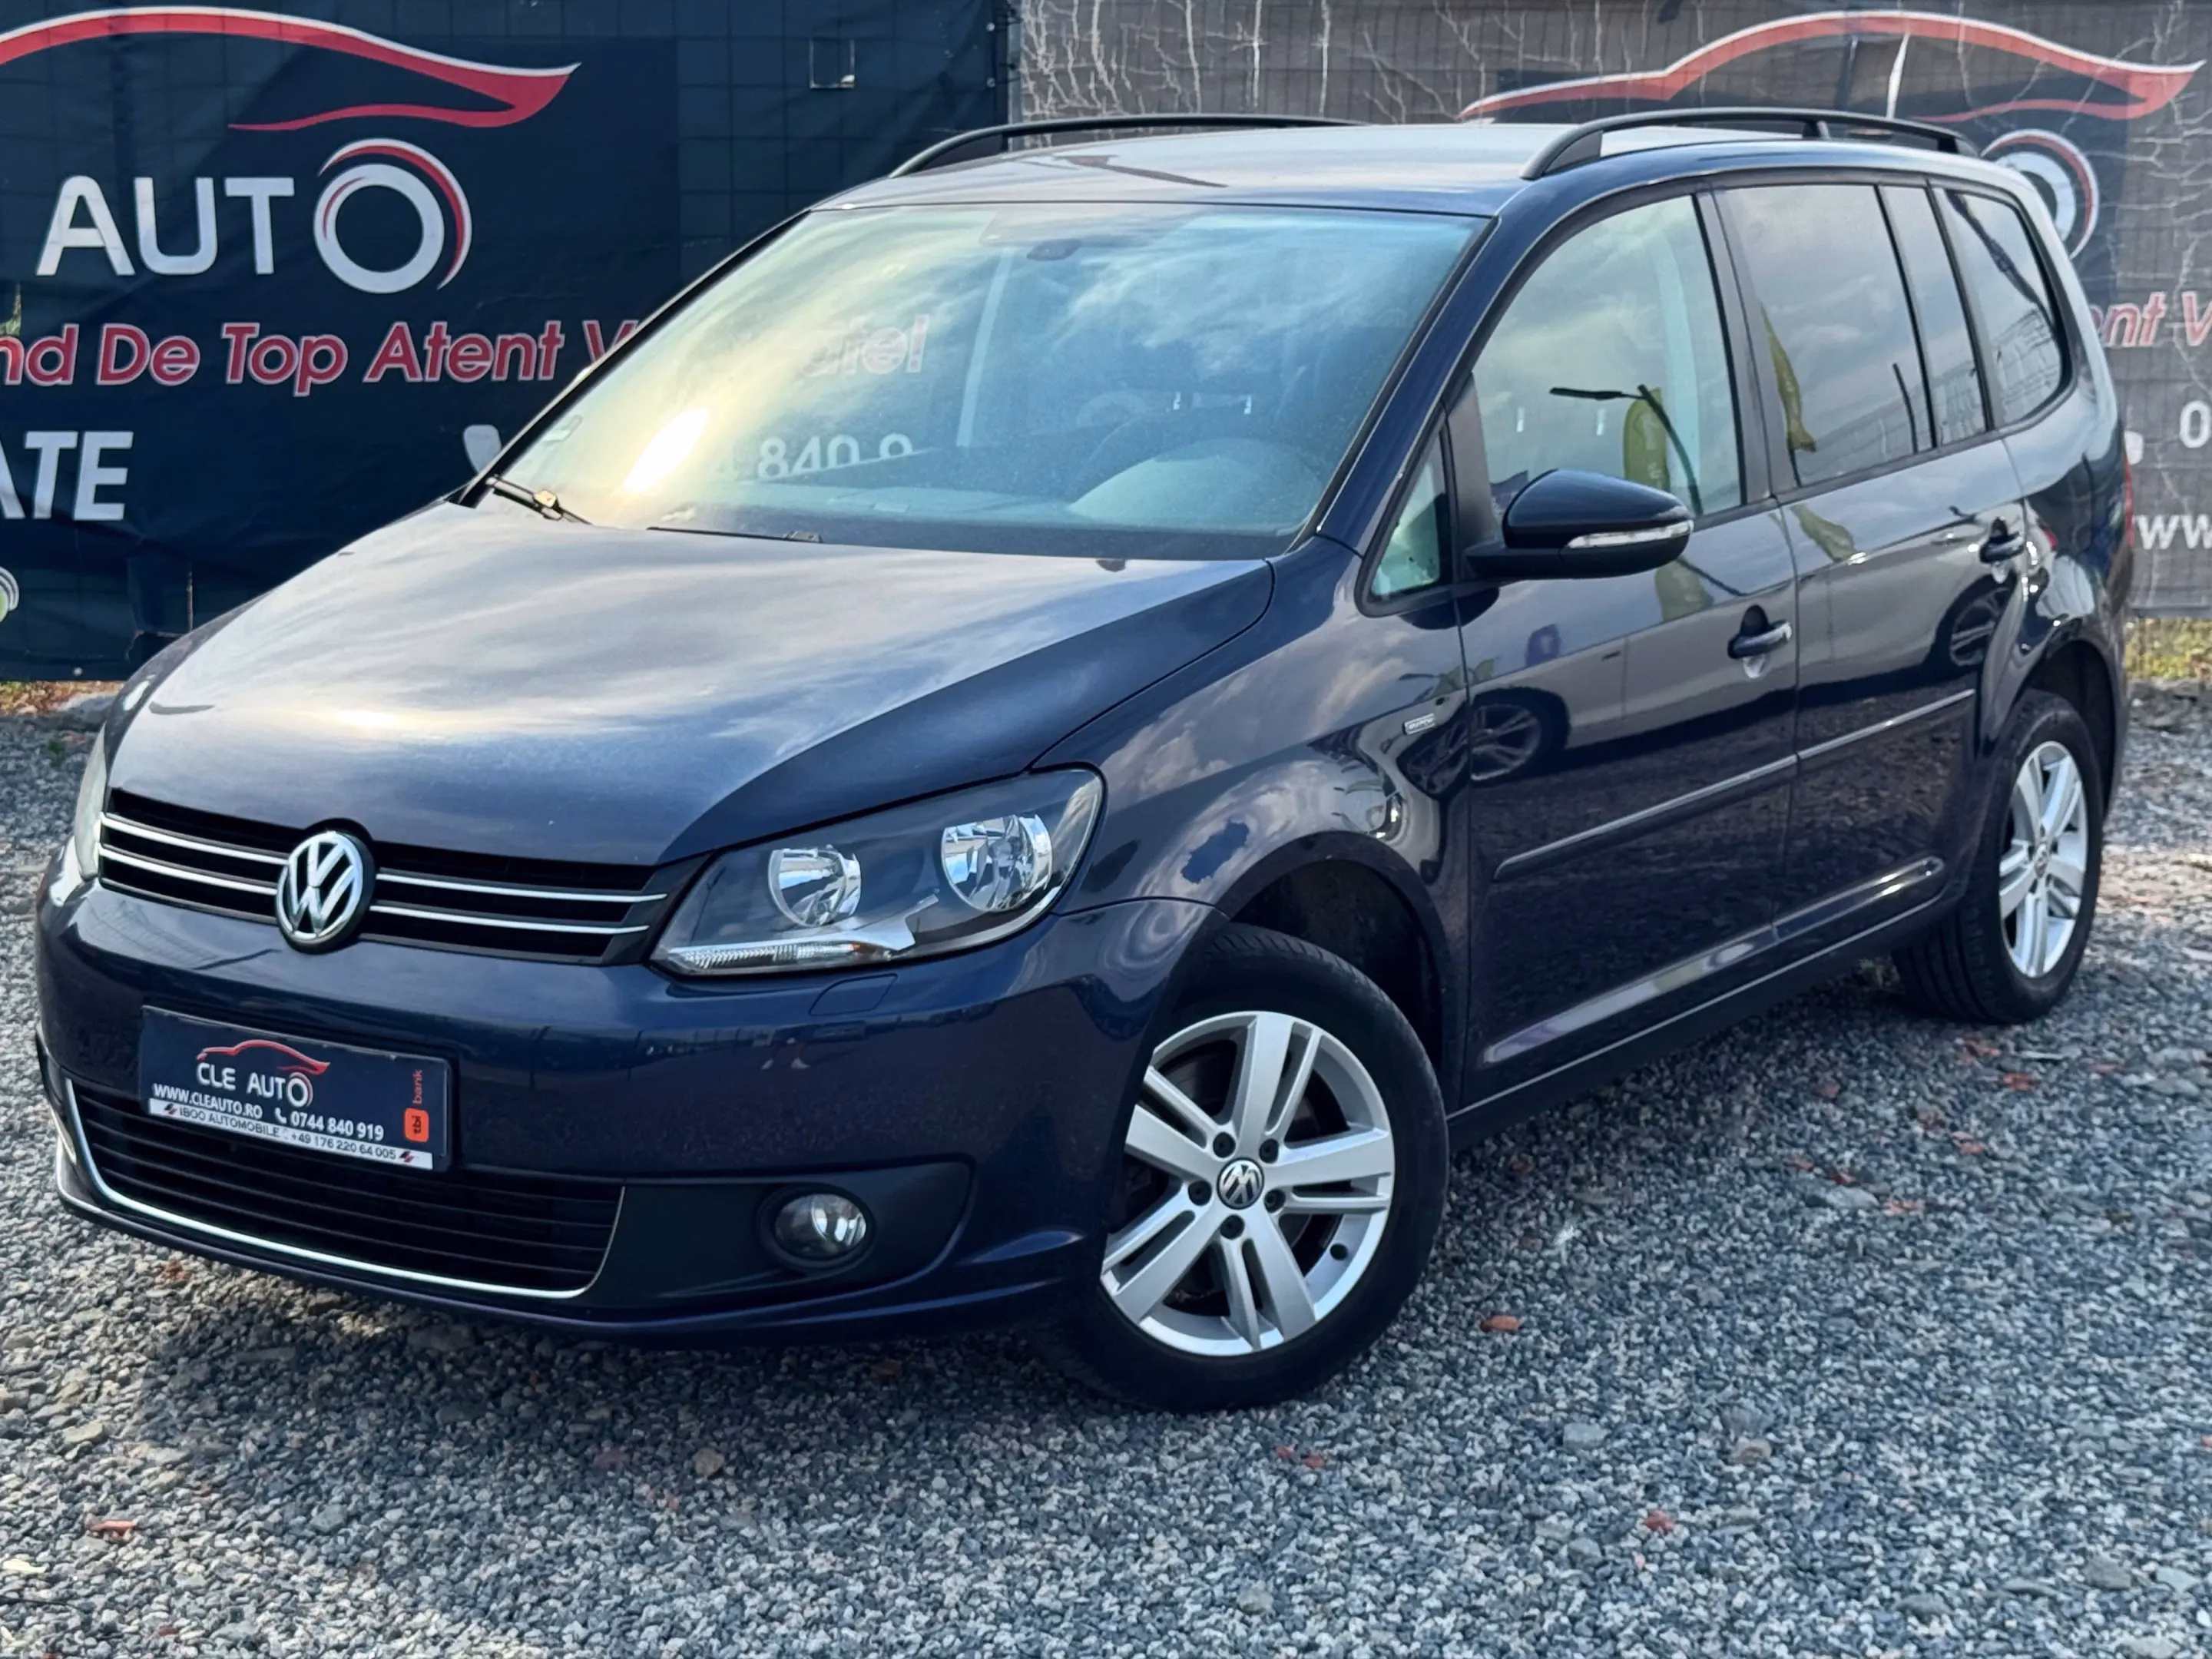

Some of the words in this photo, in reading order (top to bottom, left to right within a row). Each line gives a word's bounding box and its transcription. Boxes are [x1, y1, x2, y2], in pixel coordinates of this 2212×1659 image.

[37, 162, 445, 293] AUTO
[96, 323, 200, 385] De
[222, 322, 347, 396] Top
[363, 320, 565, 383] Atent
[153, 1083, 263, 1119] WWW.CLEAUTO.RO
[197, 1062, 236, 1091] CLE
[247, 1072, 309, 1108] AUTO
[412, 1069, 423, 1104] bank
[209, 1114, 282, 1138] AUTOMOBILE
[315, 1136, 335, 1150] 176
[336, 1140, 357, 1154] 220
[290, 1111, 324, 1131] 0744
[327, 1118, 354, 1137] 840
[356, 1122, 384, 1141] 919
